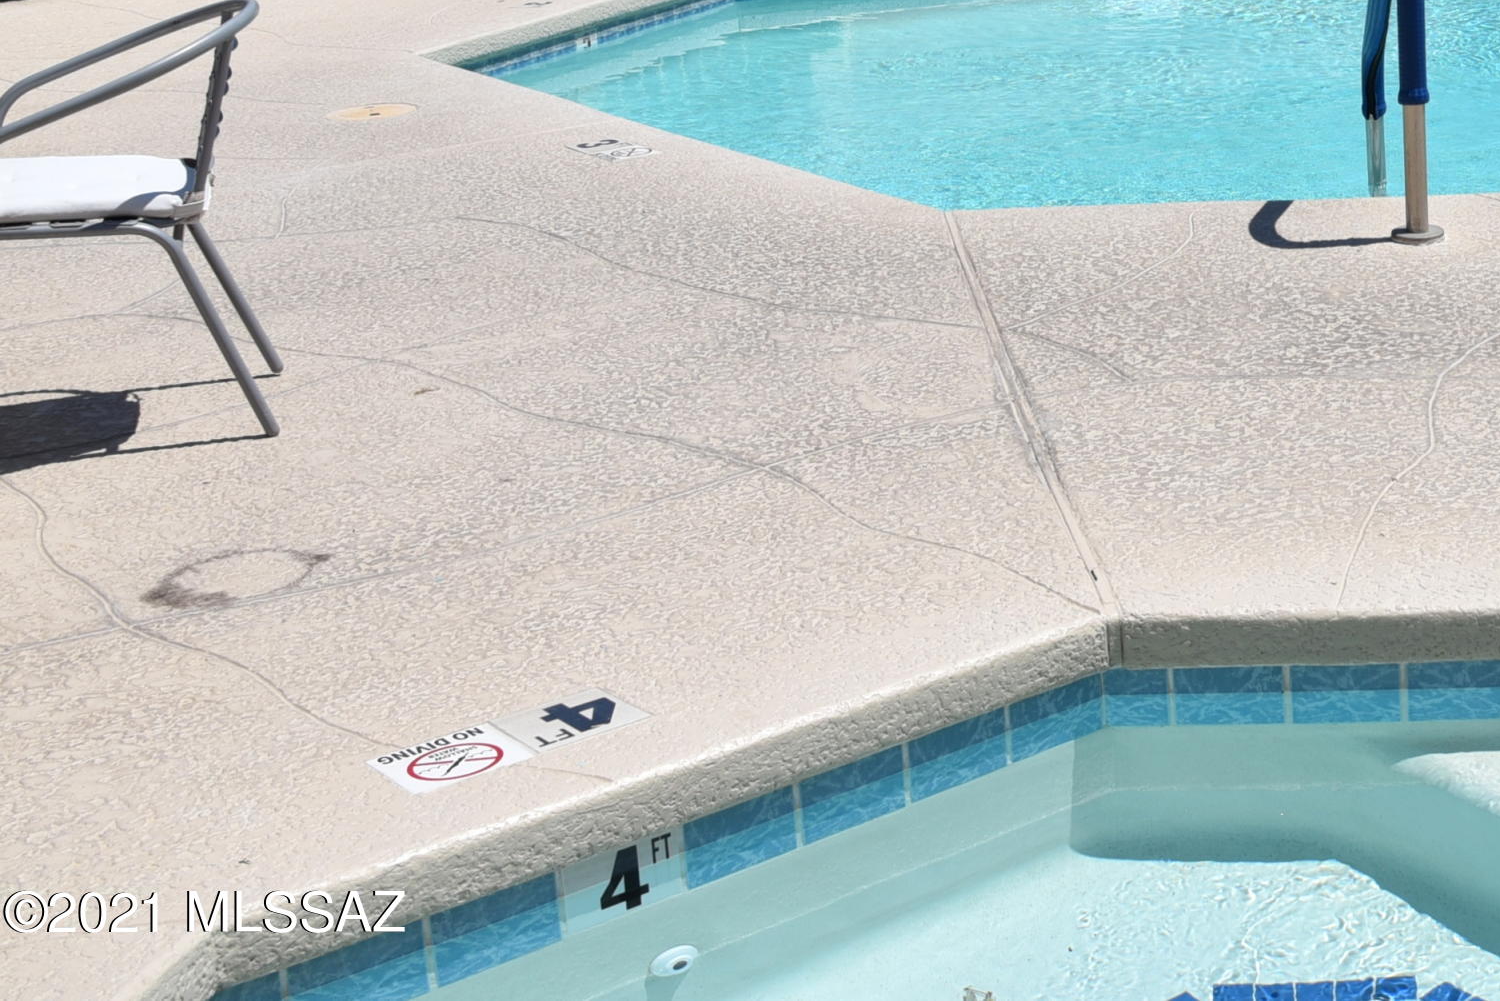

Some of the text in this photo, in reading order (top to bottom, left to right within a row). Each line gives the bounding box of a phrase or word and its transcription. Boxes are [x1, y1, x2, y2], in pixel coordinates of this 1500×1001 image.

[376, 726, 486, 765] NO DIVING
[534, 696, 617, 748] 4 FT
[600, 831, 672, 911] 4 FT
